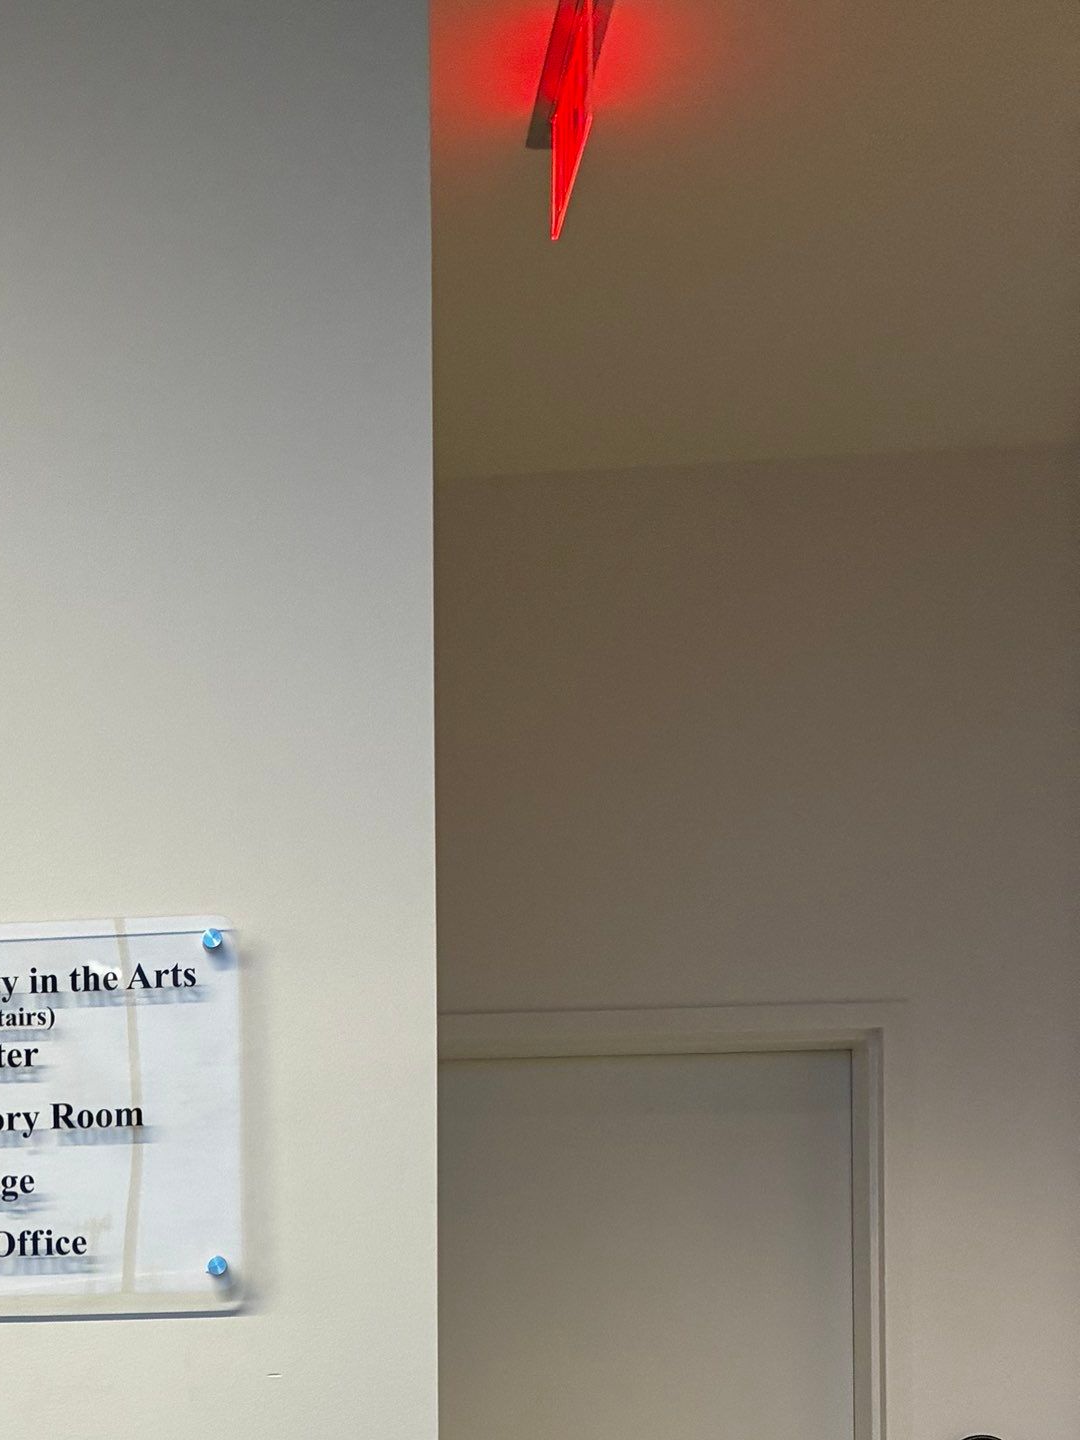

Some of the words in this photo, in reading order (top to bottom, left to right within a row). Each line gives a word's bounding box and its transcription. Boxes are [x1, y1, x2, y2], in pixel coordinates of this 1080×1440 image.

[29, 967, 63, 995] in
[69, 965, 119, 993] the
[126, 963, 197, 991] Arts
[50, 1102, 144, 1130] Room
